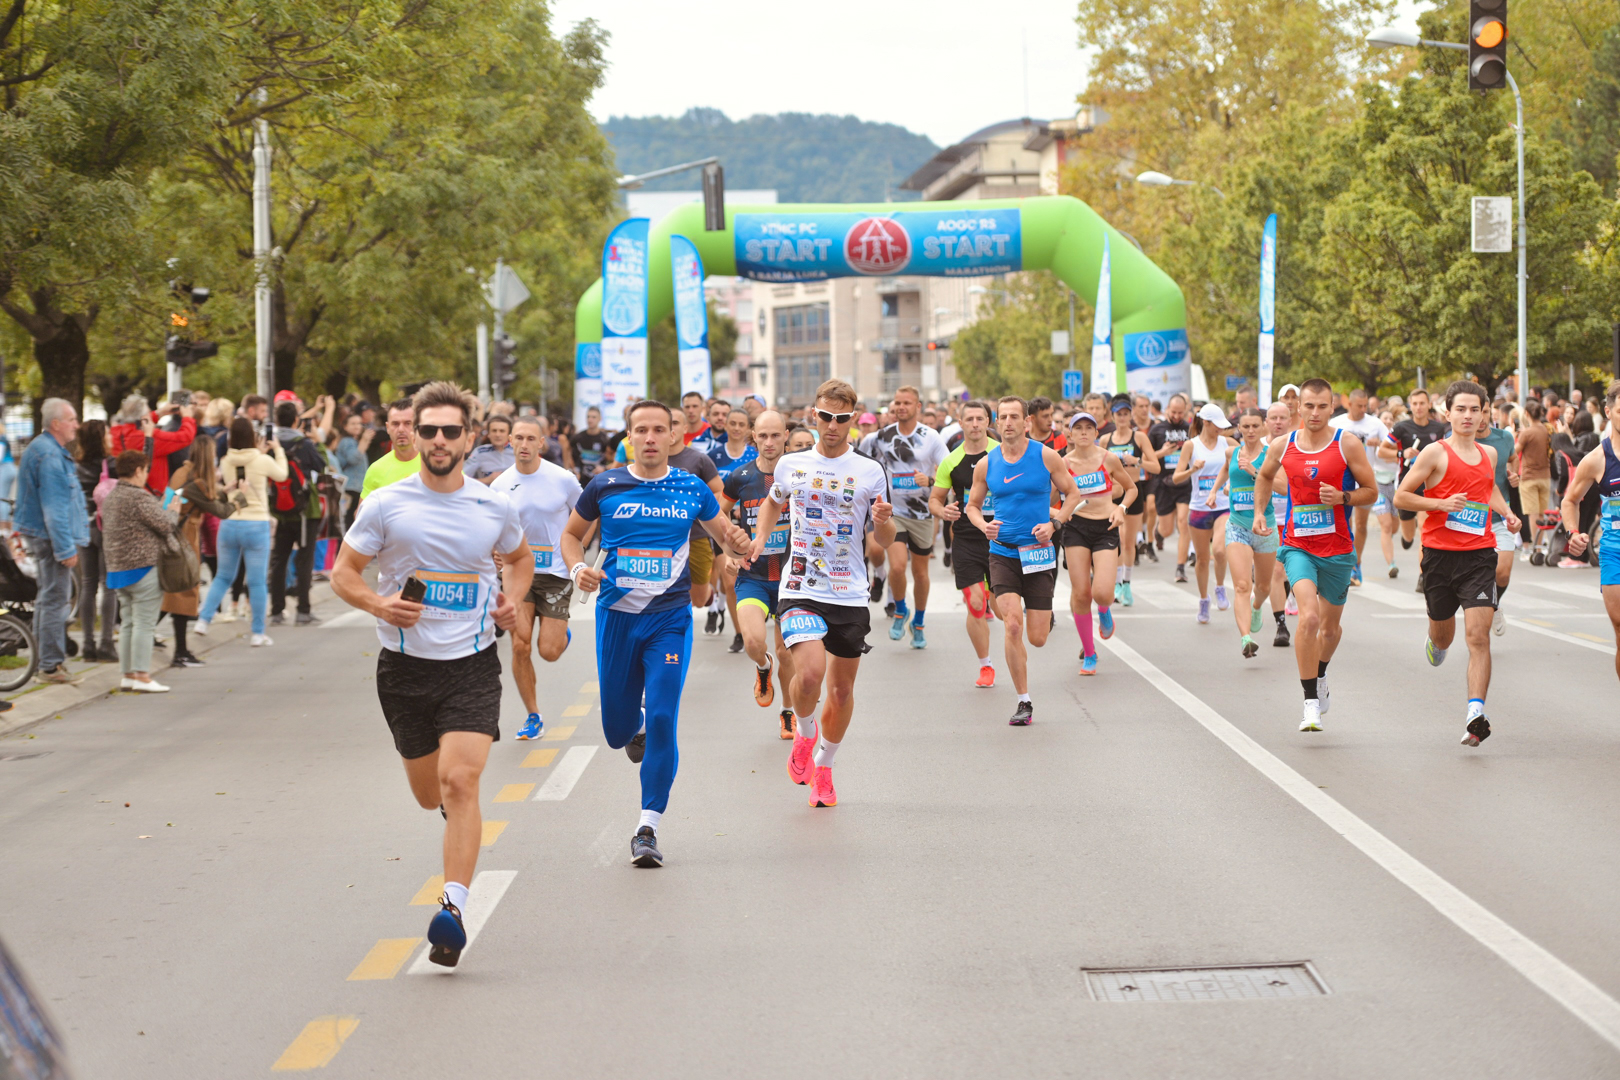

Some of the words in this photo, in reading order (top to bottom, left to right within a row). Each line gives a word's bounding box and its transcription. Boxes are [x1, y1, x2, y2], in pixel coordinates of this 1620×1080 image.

[745, 238, 833, 262] START
[923, 233, 1011, 259] START
[944, 264, 1011, 276] MARATHON
[1077, 473, 1097, 486] 3027
[641, 503, 688, 519] banka
[1457, 509, 1480, 522] 2022
[1301, 512, 1323, 525] 2151
[766, 532, 784, 544] 076
[1028, 549, 1049, 562] 4028
[629, 559, 659, 574] 3015
[430, 583, 464, 602] 1054
[790, 616, 817, 630] 4041
